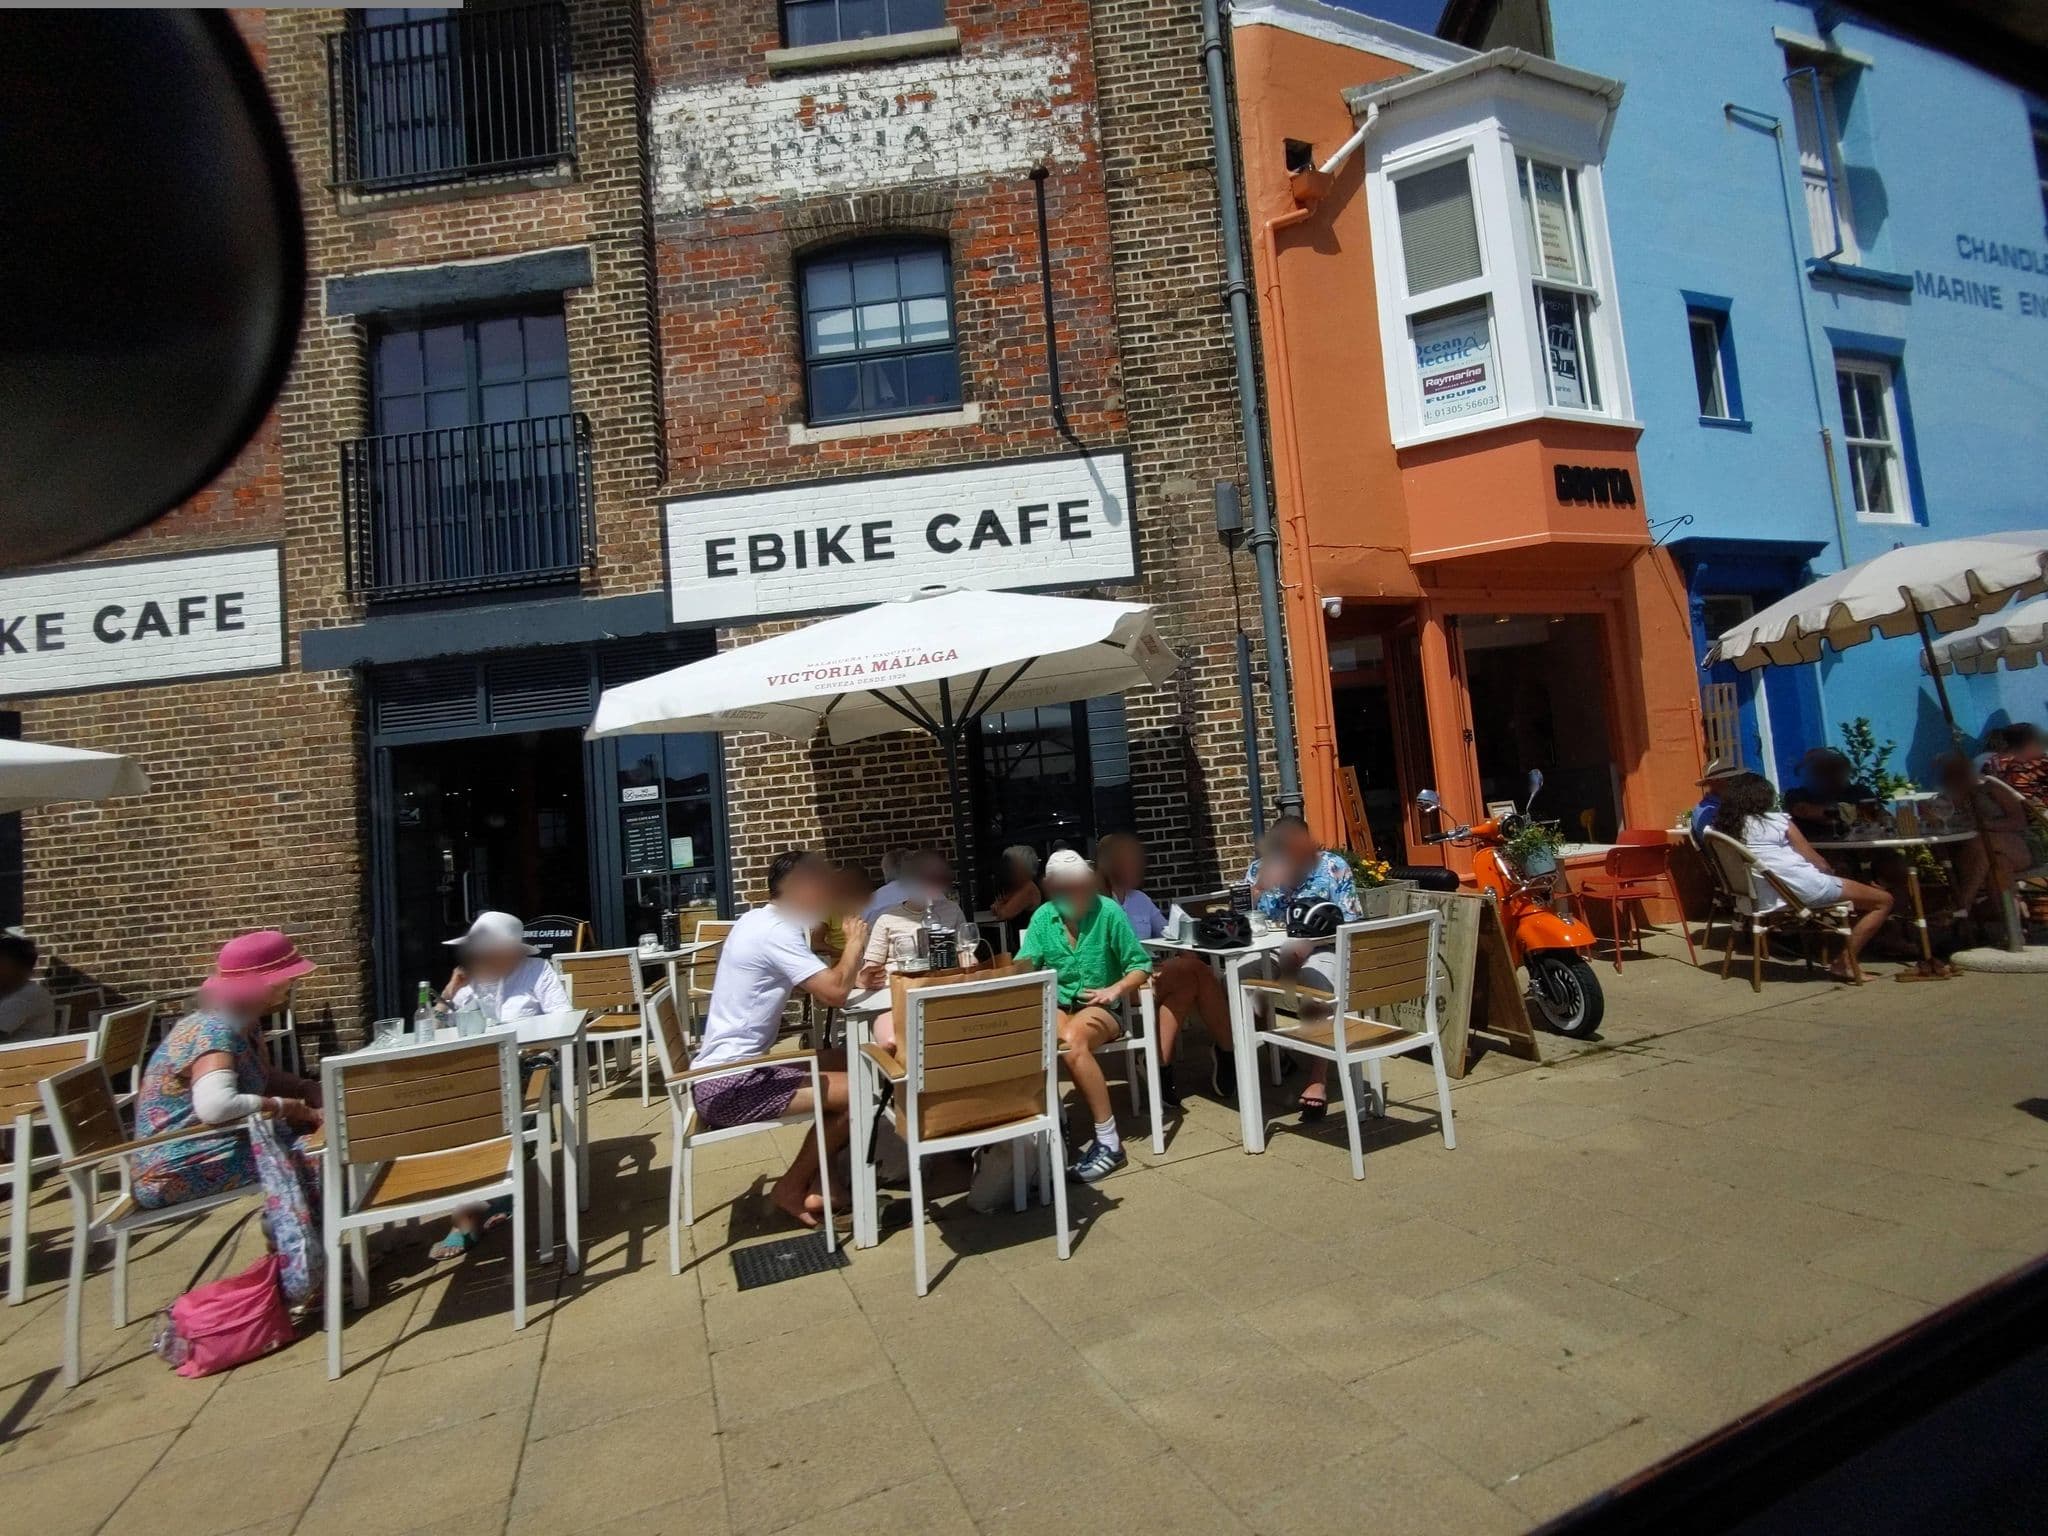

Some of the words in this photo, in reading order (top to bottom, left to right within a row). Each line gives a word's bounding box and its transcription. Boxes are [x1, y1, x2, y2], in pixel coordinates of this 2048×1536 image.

[1915, 269, 2003, 310] MARINE
[2018, 291, 2048, 318] EN
[1417, 347, 1472, 368] lectric
[1425, 367, 1482, 388] Raymarine
[1426, 385, 1486, 404] FURUNO
[1434, 404, 1463, 417] 01305
[706, 520, 896, 579] EBIKE
[925, 499, 1092, 555] CAFE
[93, 591, 245, 644] CAFE
[767, 663, 865, 687] VICTORIA
[872, 648, 959, 673] MÁLAGA
[814, 681, 855, 691] CERVEZA
[857, 676, 887, 685] DESDE
[539, 929, 555, 938] CAFE
[560, 929, 573, 937] BAR
